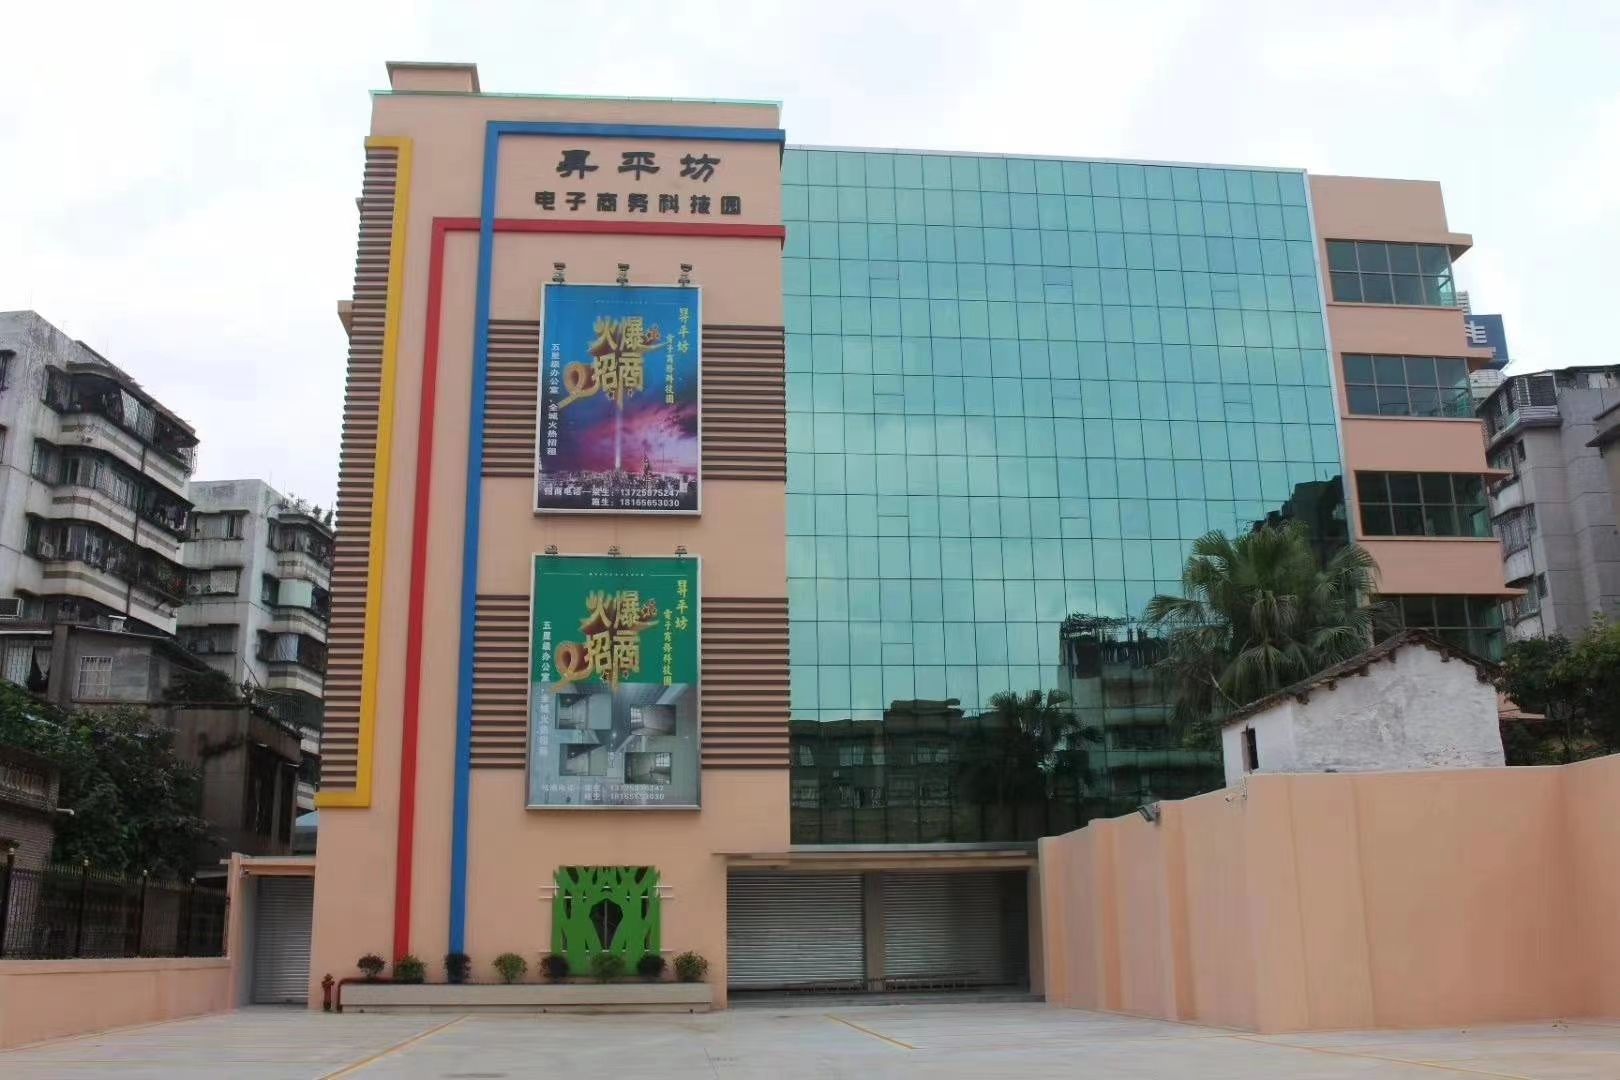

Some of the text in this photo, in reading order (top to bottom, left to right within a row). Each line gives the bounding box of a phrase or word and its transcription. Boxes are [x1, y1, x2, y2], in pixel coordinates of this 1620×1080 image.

[556, 149, 721, 183] 昇平坊
[534, 190, 742, 216] 电子商务科技园
[590, 316, 646, 352] 火爆
[579, 589, 640, 628] 火爆
